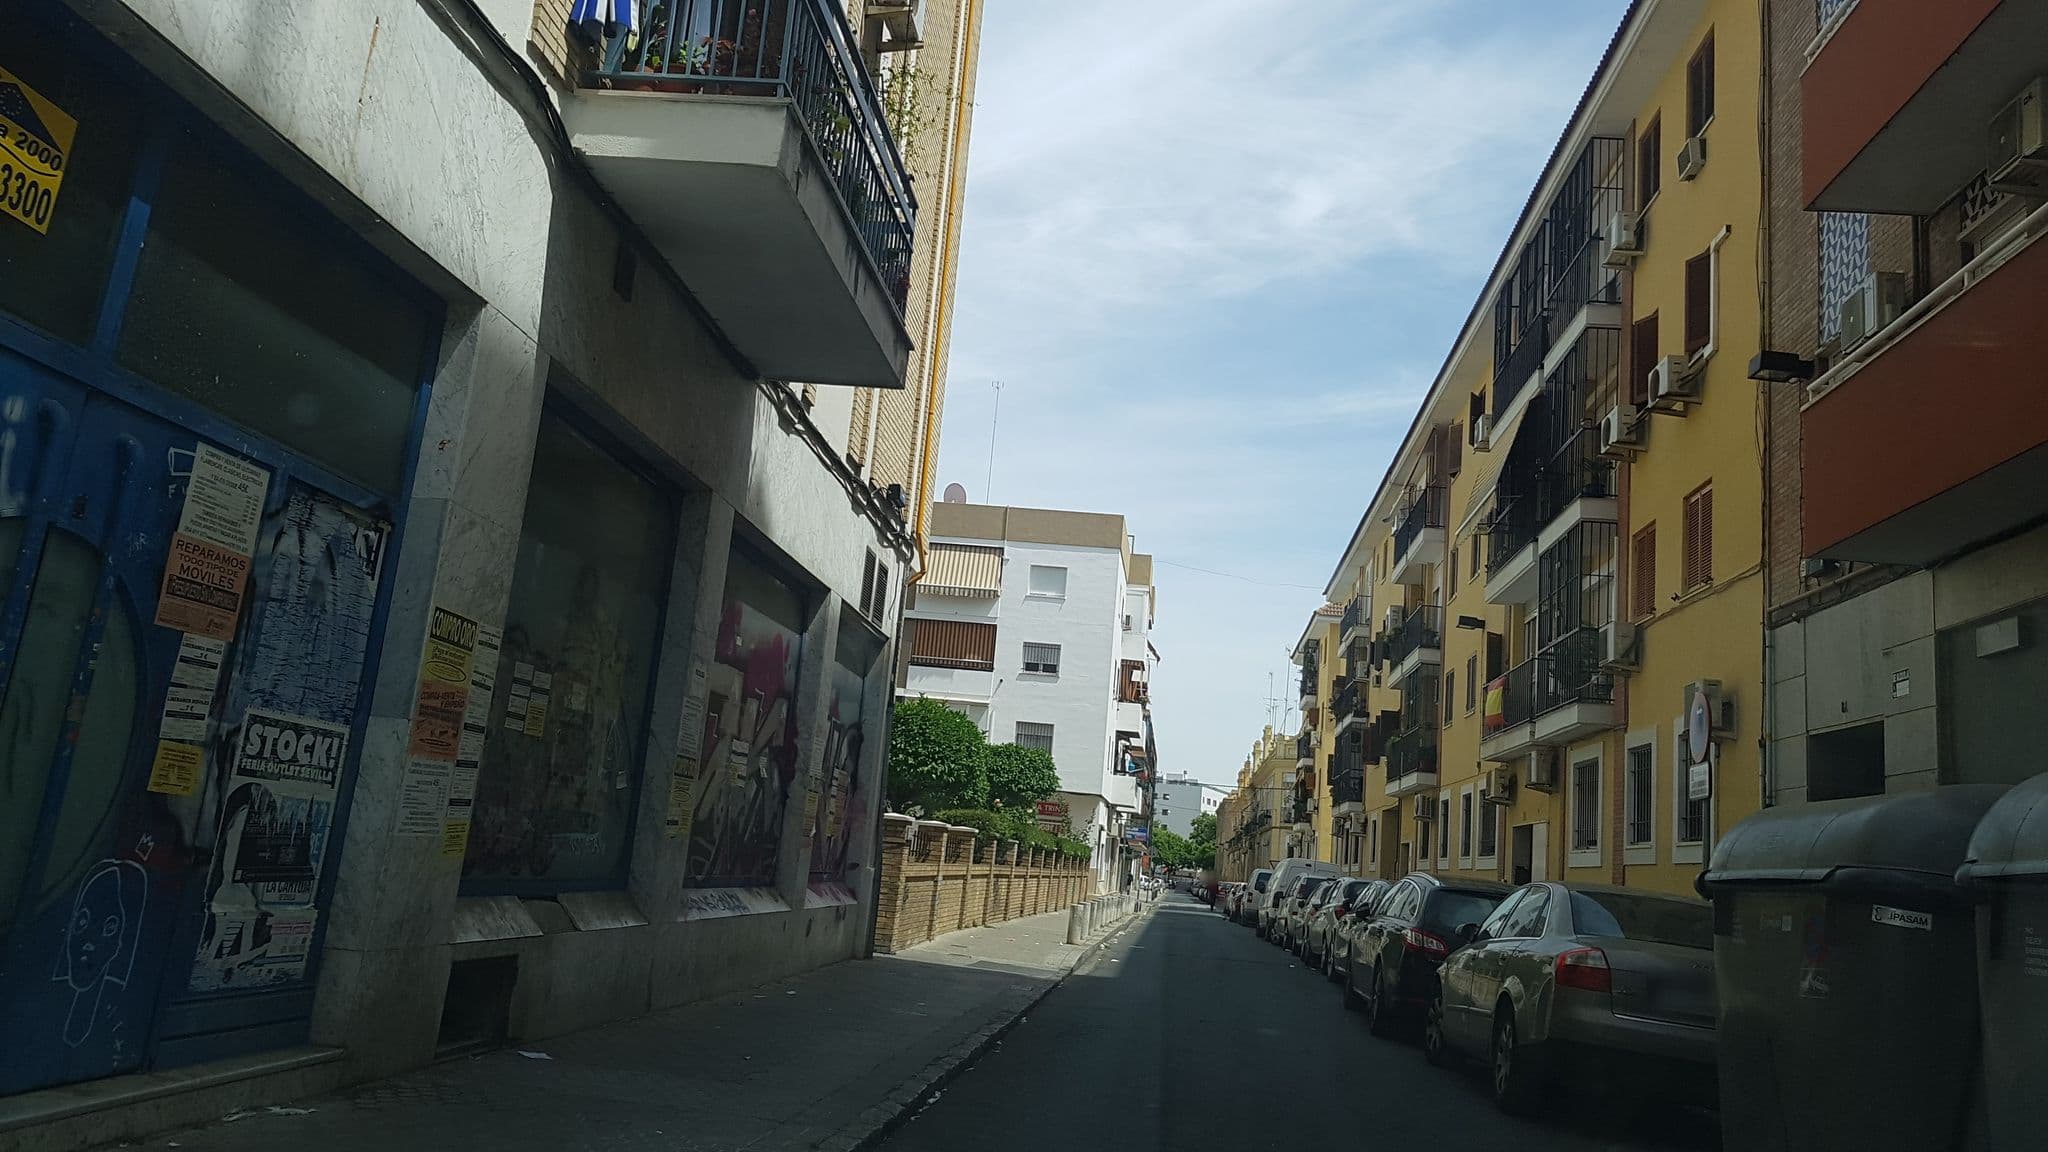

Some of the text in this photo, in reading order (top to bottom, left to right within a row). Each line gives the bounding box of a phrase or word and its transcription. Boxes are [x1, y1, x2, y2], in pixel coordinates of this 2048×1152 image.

[14, 131, 64, 171] 2000
[175, 538, 246, 570] REPARAMOS
[178, 553, 240, 578] TODO TIPO DE
[179, 563, 235, 590] MOVILES
[432, 609, 461, 643] COMPRO
[246, 723, 338, 769] STOCK!
[240, 757, 333, 782] FERIA OUTLET SEVILLA
